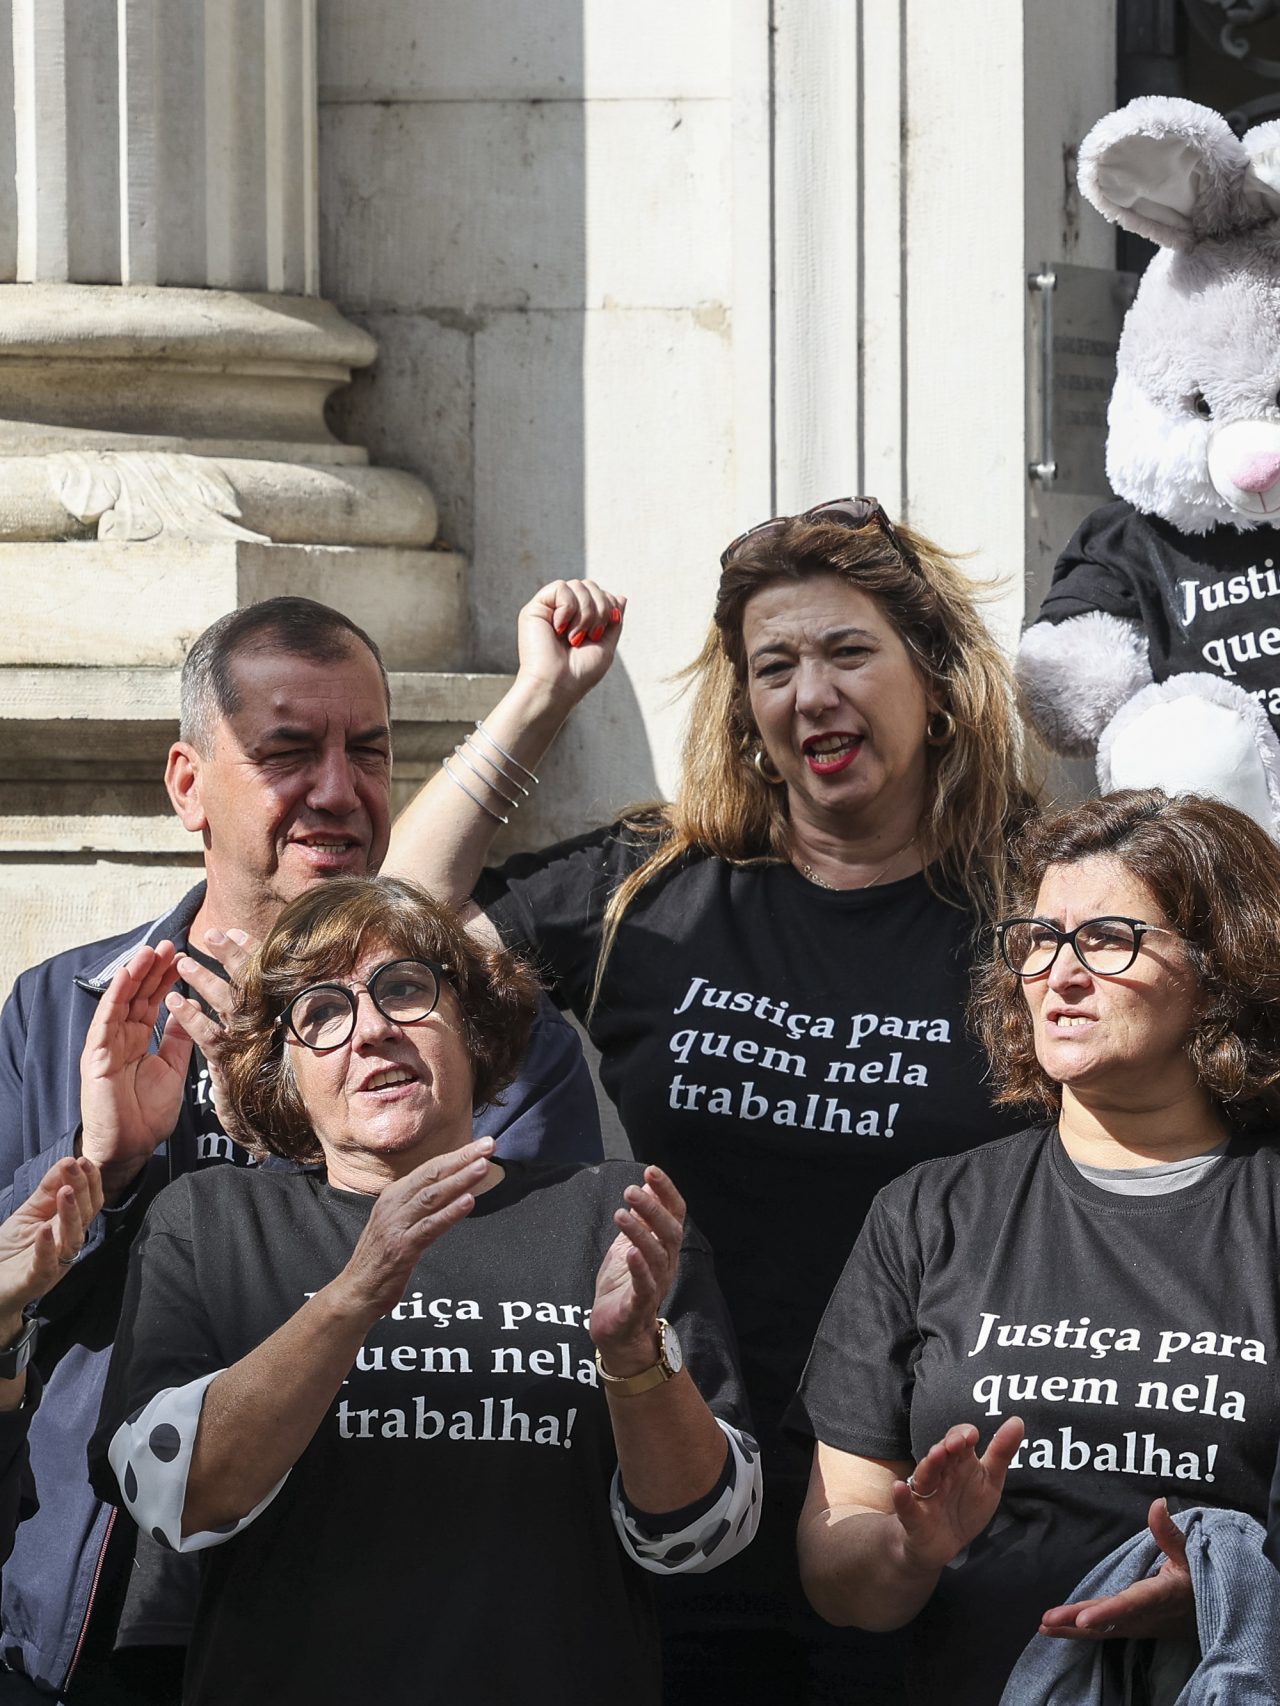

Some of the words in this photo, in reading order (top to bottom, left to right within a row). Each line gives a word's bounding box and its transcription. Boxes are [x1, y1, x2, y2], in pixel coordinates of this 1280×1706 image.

[673, 977, 835, 1040] Justiça
[846, 1012, 951, 1049] para
[669, 1027, 807, 1078] quem
[823, 1052, 929, 1087] nela
[668, 1074, 900, 1138] trabalha!
[342, 1346, 473, 1385] uem
[491, 1343, 599, 1389] nela
[967, 1312, 1141, 1359] Justiça
[1153, 1329, 1268, 1365] para
[335, 1395, 578, 1449] trabalha!
[972, 1373, 1119, 1417] quem
[1134, 1374, 1246, 1422] nela
[993, 1426, 1219, 1483] rabalha!
